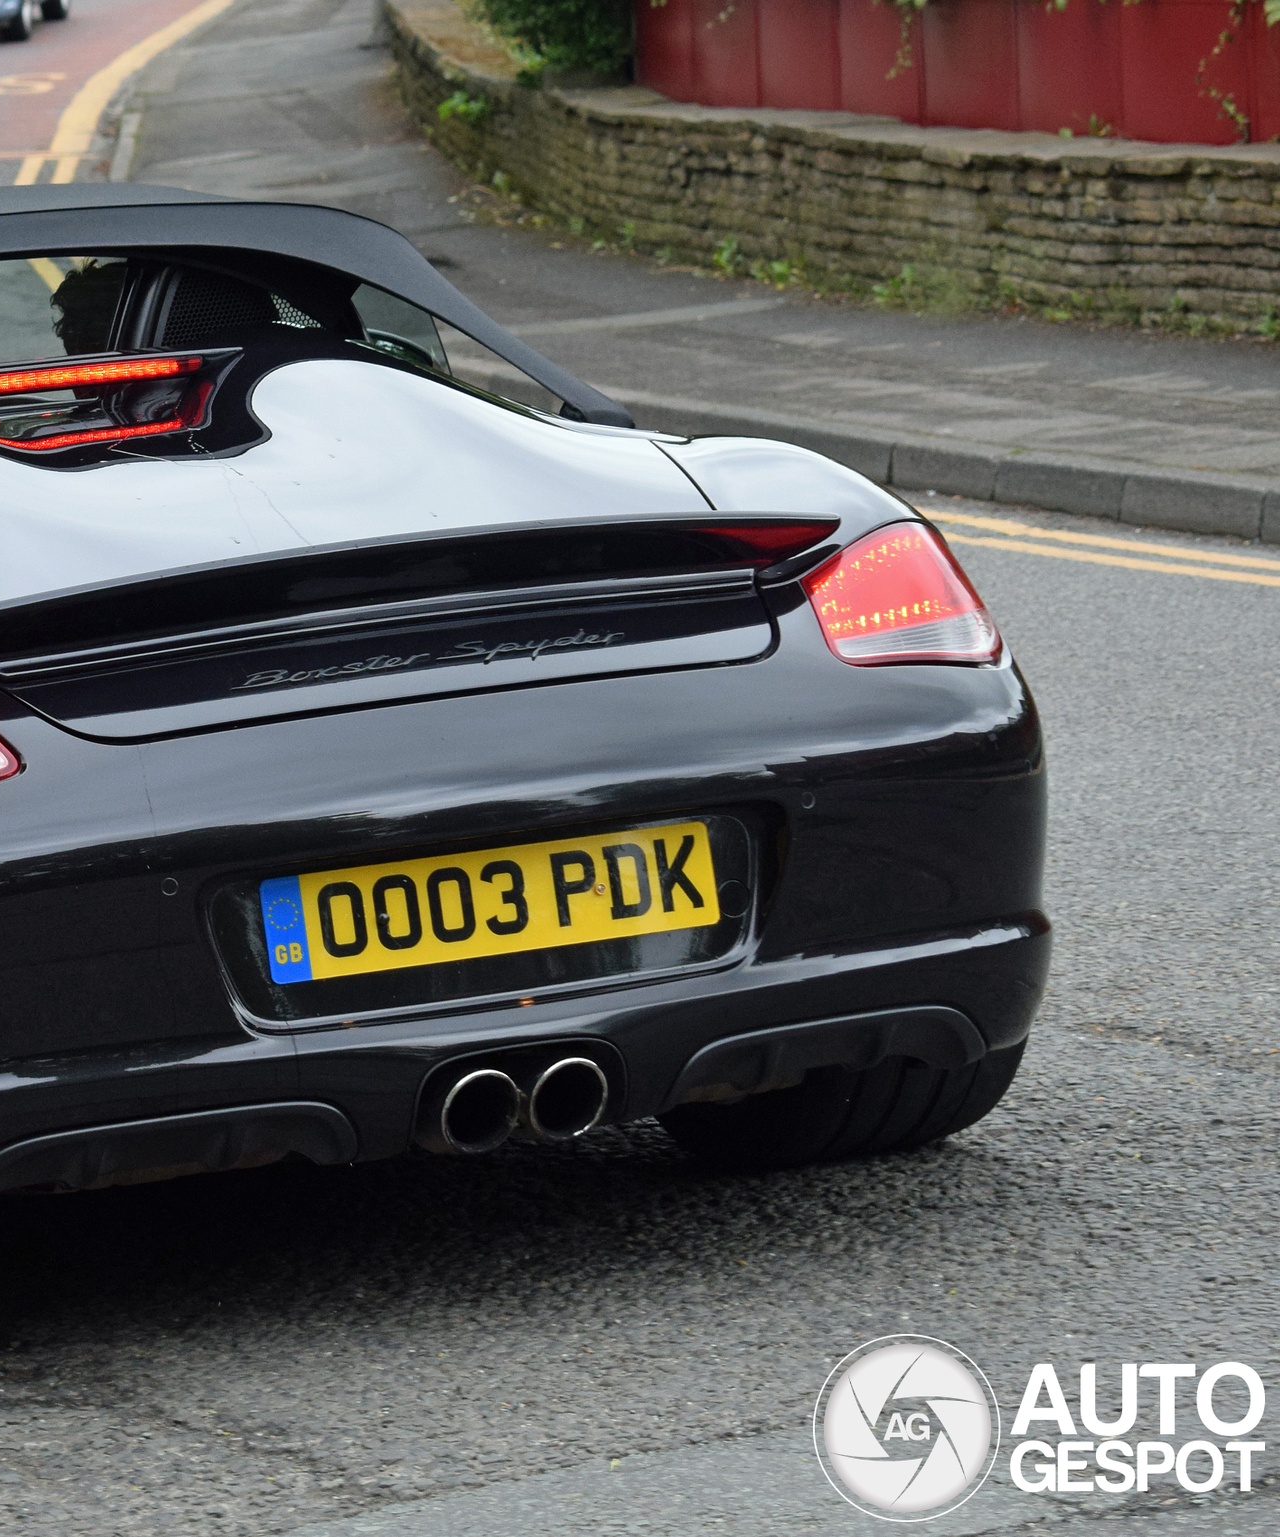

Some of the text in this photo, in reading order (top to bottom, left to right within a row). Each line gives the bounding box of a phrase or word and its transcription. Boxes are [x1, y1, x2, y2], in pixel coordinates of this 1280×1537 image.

[231, 629, 625, 691] Boxster Spyder
[549, 834, 705, 927] PDK
[275, 942, 303, 964] GB
